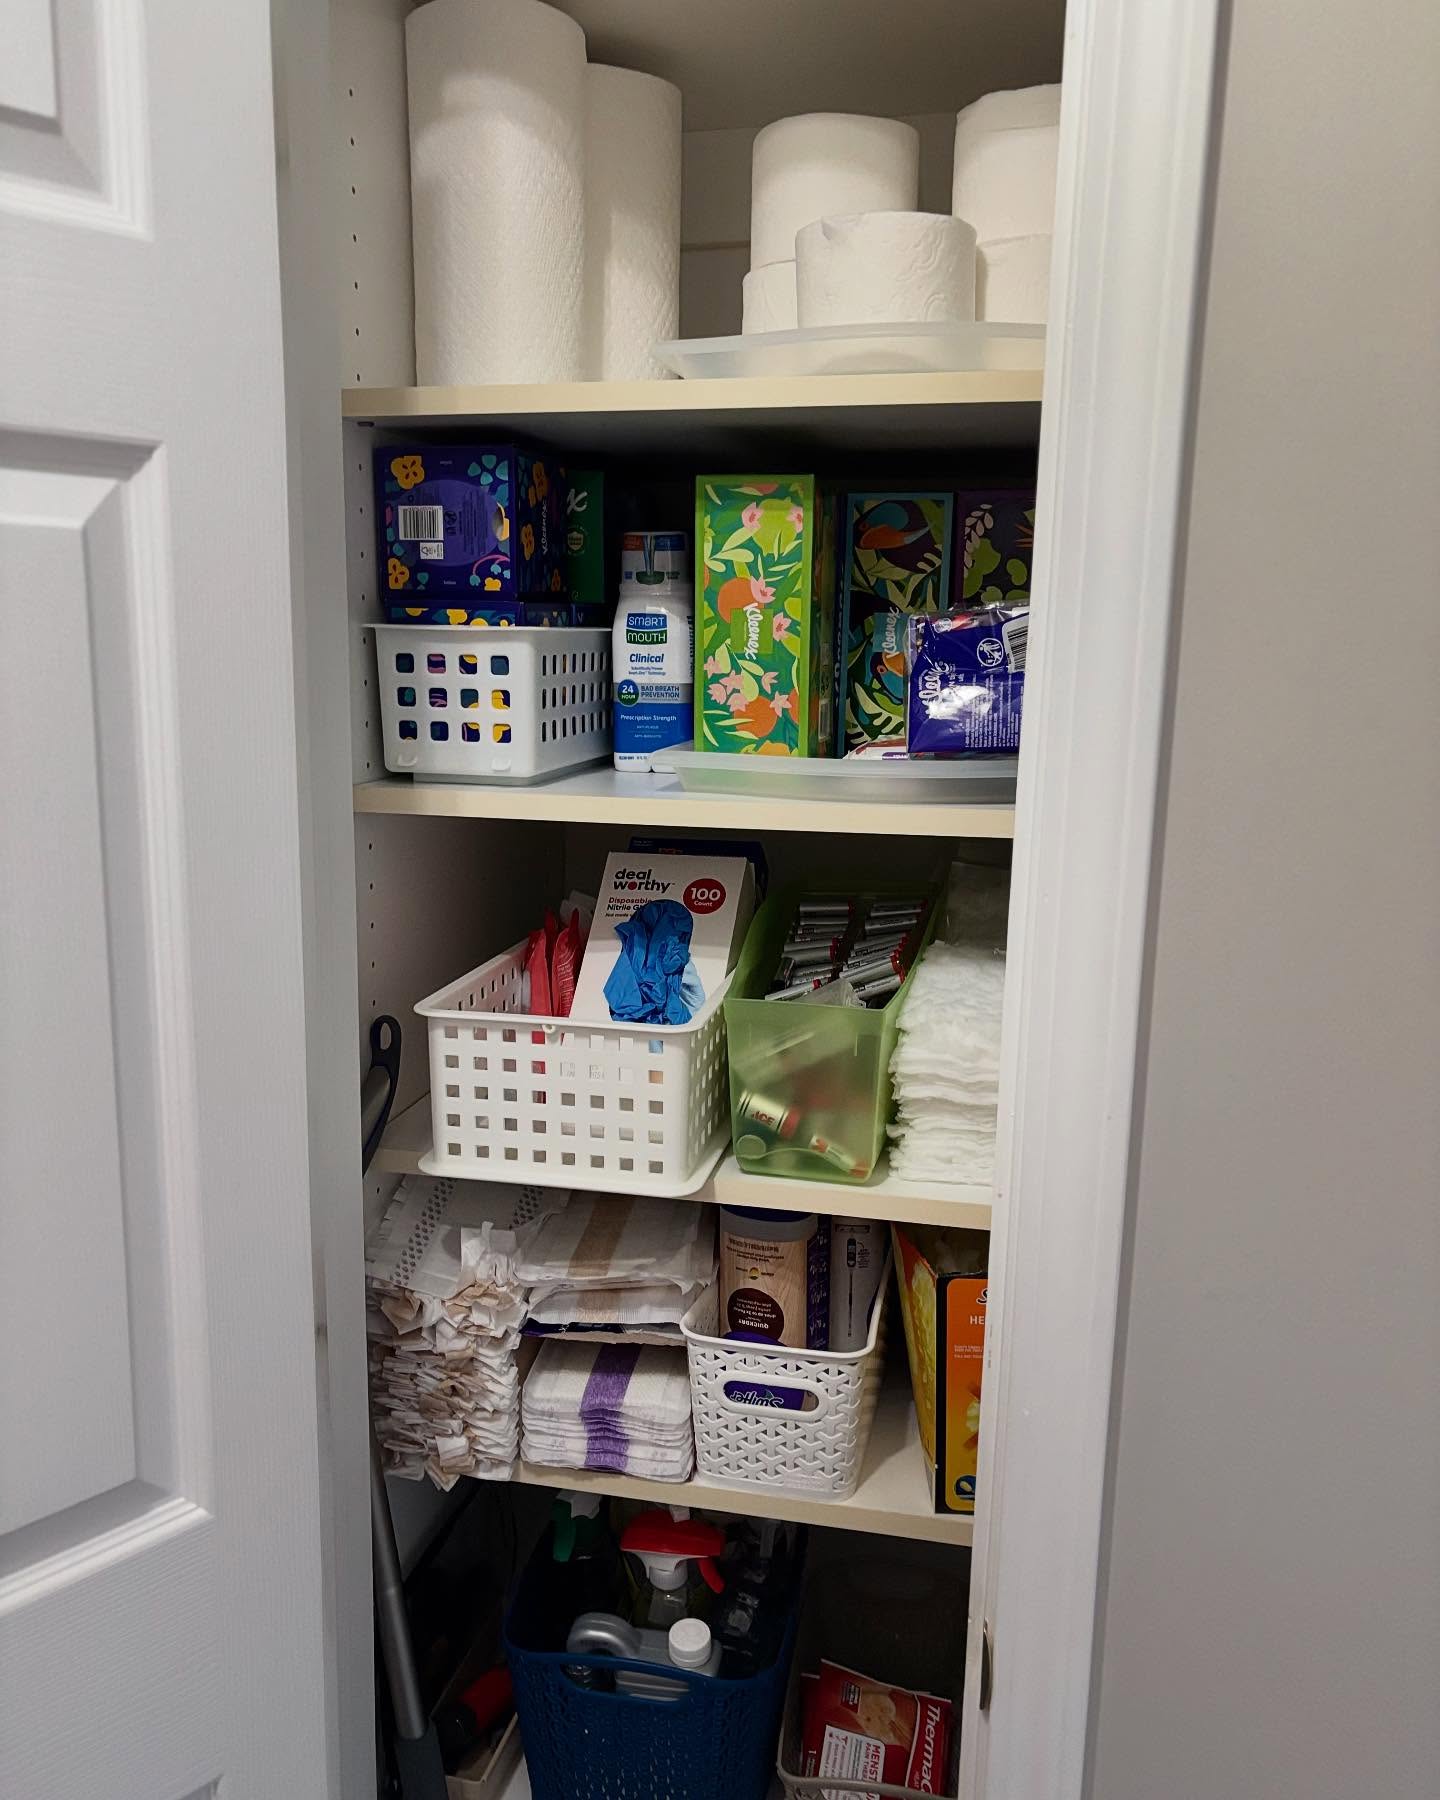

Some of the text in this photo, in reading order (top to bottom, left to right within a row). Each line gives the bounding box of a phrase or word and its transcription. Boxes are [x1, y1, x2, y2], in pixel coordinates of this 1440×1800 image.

[627, 631, 666, 642] MOUTH
[742, 602, 759, 660] Kleenex
[883, 606, 900, 656] Kleenex
[629, 653, 665, 663] Clinical
[622, 685, 634, 693] 24
[620, 714, 677, 723] Prescription Strength
[614, 868, 652, 880] deal
[613, 880, 672, 894] worthy
[690, 888, 721, 902] 100
[607, 903, 631, 911] Nitrile
[920, 1703, 941, 1795] ThermaC
